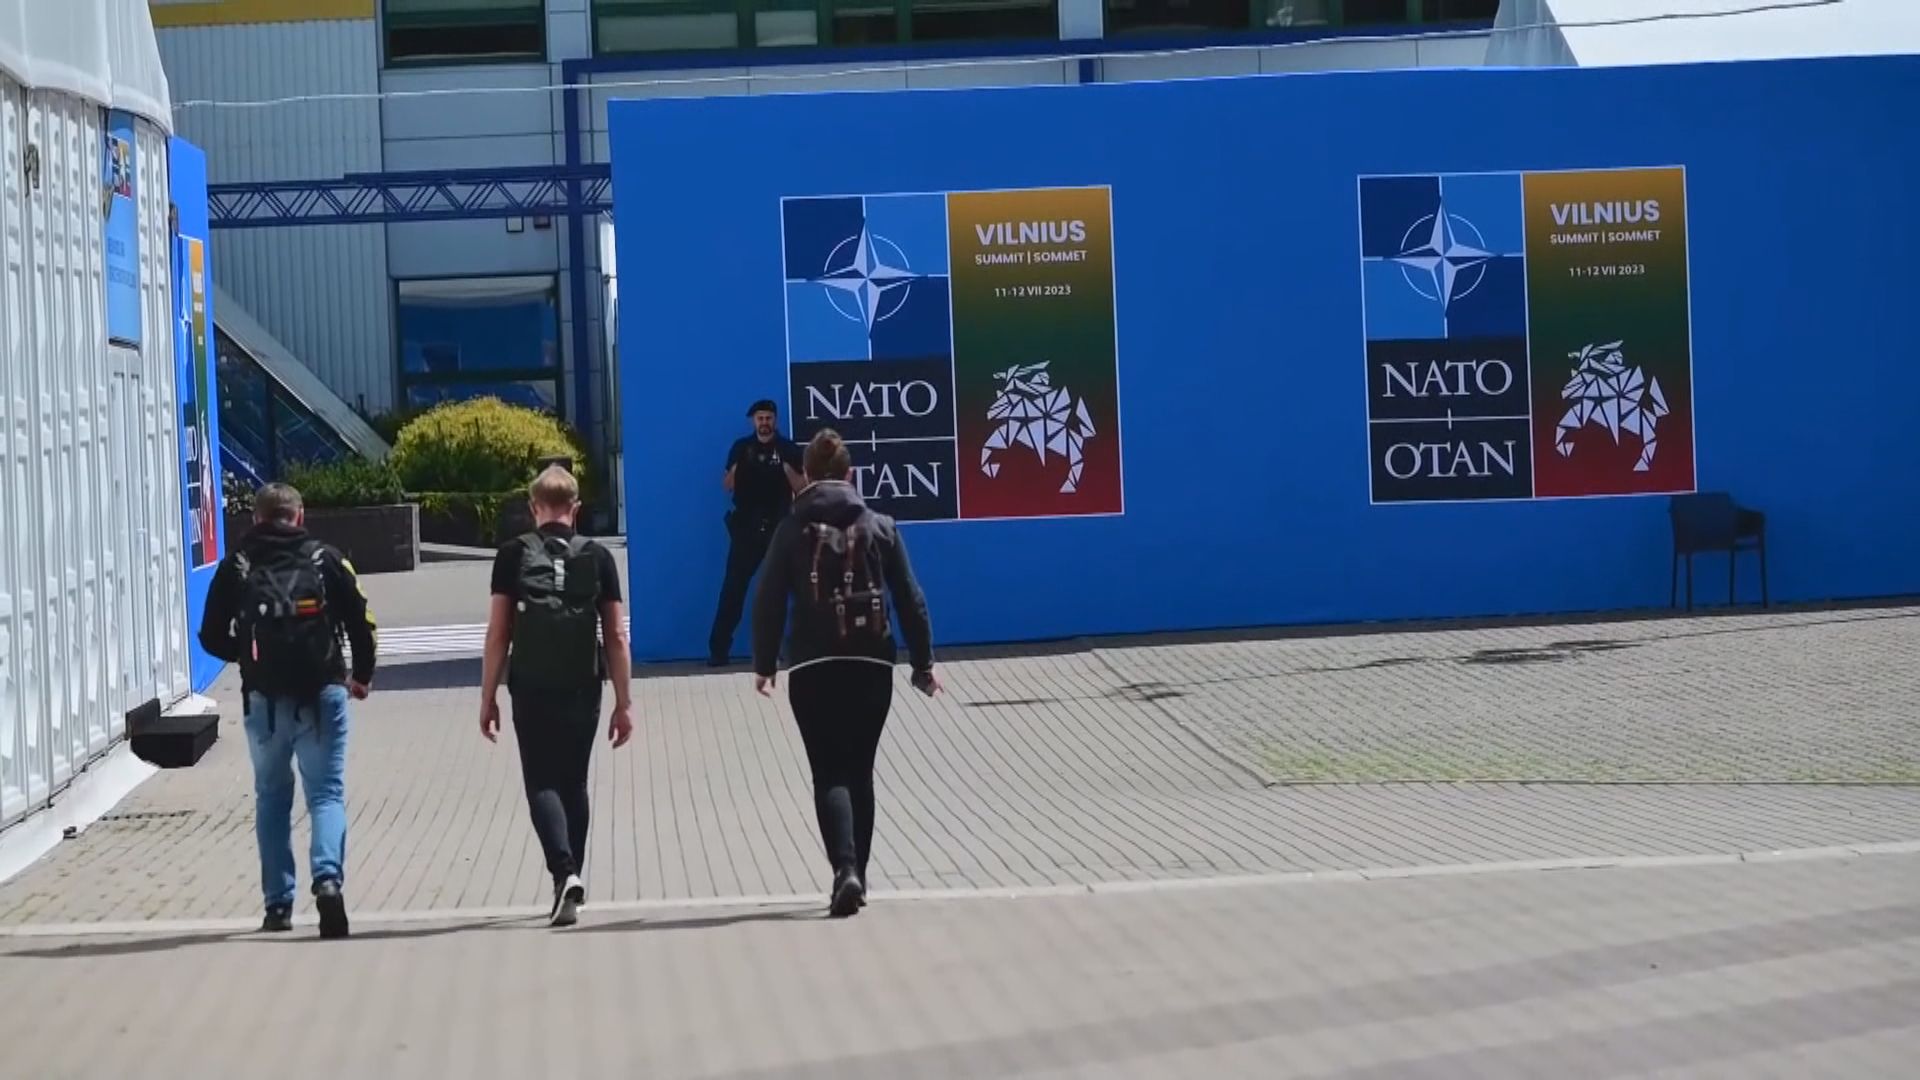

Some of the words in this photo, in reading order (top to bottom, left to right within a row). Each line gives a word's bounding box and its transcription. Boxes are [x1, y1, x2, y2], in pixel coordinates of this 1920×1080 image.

[1550, 199, 1660, 225] VILNIUS
[975, 220, 1086, 246] VILNIUS
[1550, 231, 1599, 245] SUMMIT
[1608, 230, 1662, 243] SOMMET
[975, 252, 1025, 265] SUMMIT
[1033, 250, 1088, 263] SOMMET
[1569, 265, 1600, 277] 11-12
[1601, 265, 1616, 276] VII
[1618, 263, 1646, 275] 2023
[994, 286, 1025, 297] 11-12
[1026, 285, 1042, 296] VII
[1044, 284, 1072, 296] 2023
[1381, 359, 1513, 397] NATO
[805, 380, 938, 420] NATO
[1384, 440, 1517, 479] OTAN
[849, 462, 942, 500] TAN
